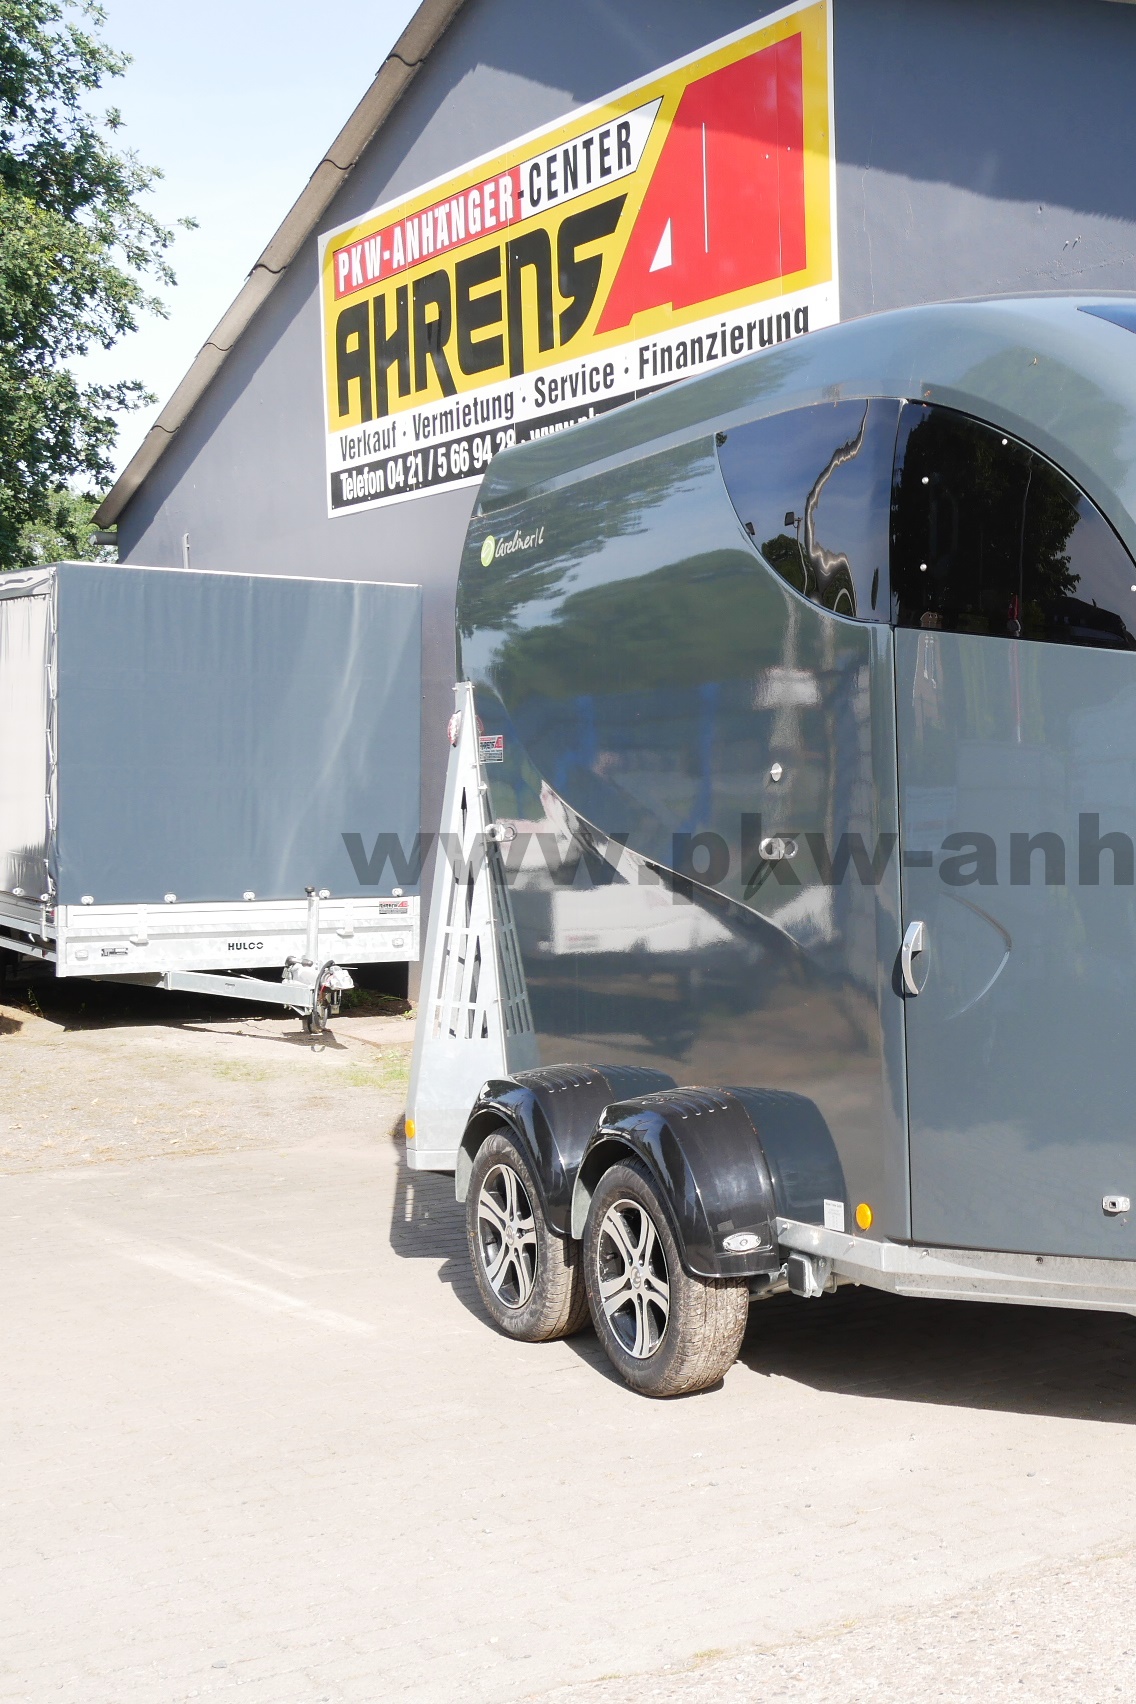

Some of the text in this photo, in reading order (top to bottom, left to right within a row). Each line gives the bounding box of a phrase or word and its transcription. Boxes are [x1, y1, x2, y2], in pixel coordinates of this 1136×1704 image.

[338, 120, 633, 292] PKW-ANHÄNGER-CENTER
[335, 193, 628, 425] AHRENS
[340, 421, 397, 462] Verkauf
[412, 389, 514, 441] Vermietung
[534, 358, 615, 408] Service
[340, 467, 385, 501] Telefon
[387, 458, 405, 490] 04
[406, 453, 423, 485] 21
[437, 447, 448, 478] 5
[450, 441, 469, 474] 66
[472, 435, 492, 469] 94
[227, 941, 264, 951] HULCO
